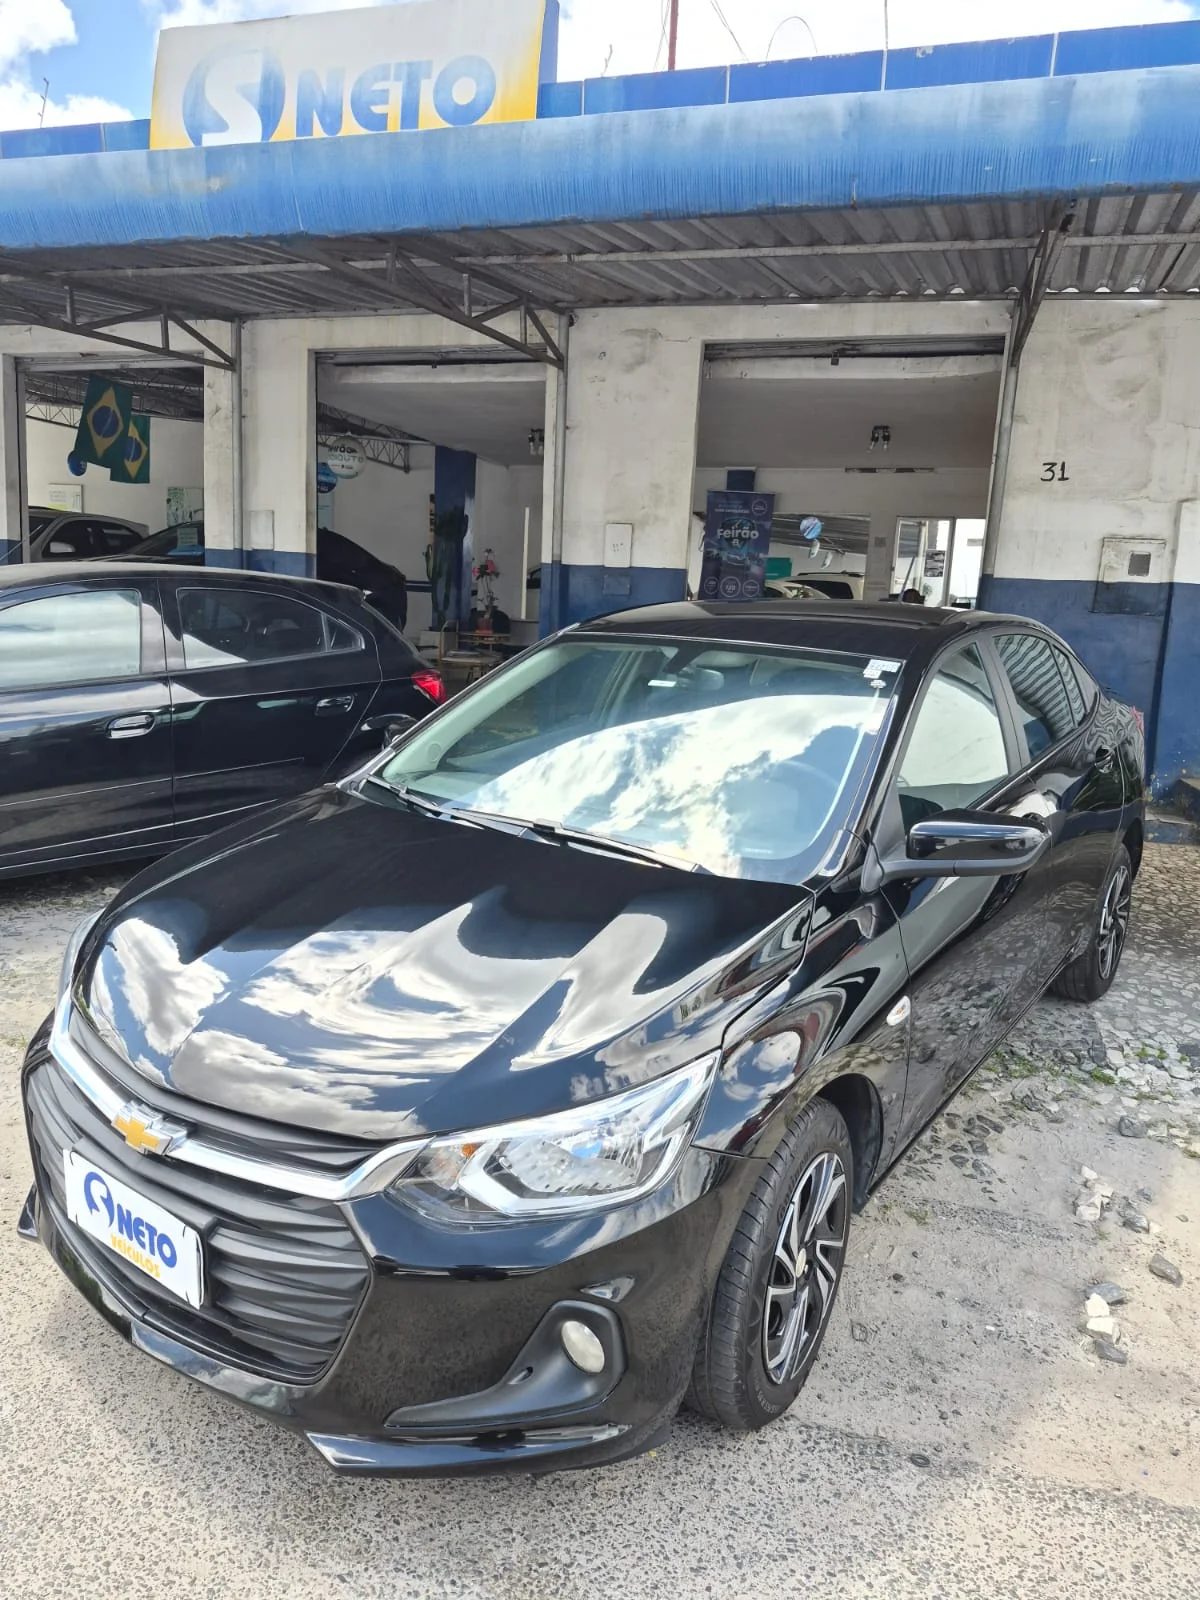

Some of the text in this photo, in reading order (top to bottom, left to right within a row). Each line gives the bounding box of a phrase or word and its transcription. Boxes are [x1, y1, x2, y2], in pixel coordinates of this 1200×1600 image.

[295, 54, 497, 137] NETO
[1040, 461, 1069, 482] 31
[717, 526, 759, 539] Feirão
[117, 1203, 177, 1269] NETO
